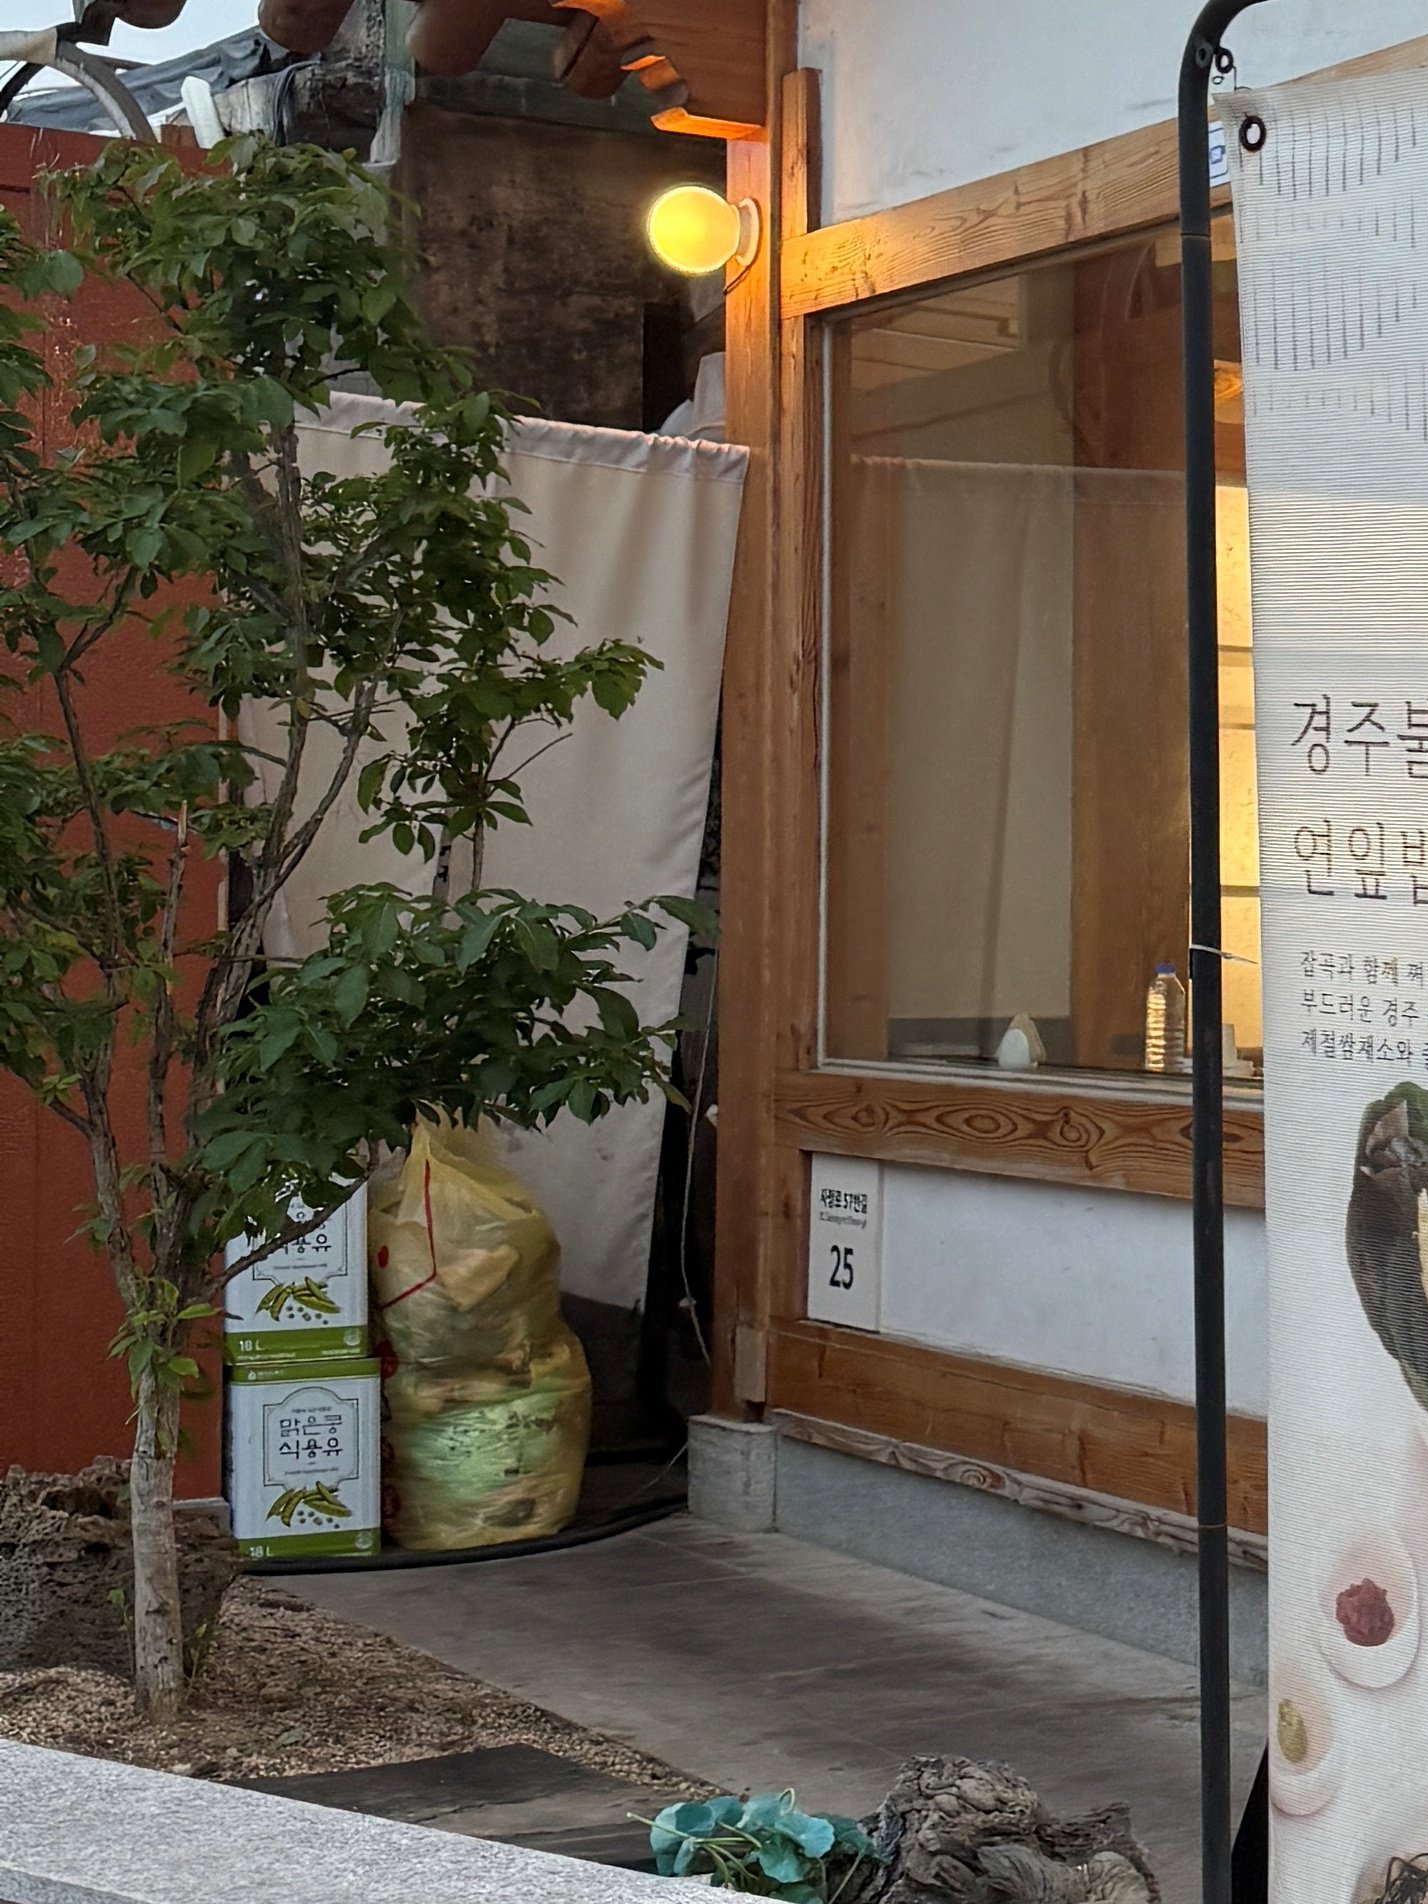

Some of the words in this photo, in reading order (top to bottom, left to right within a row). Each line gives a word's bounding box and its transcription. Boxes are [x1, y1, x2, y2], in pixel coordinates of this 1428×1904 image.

[1301, 950, 1354, 980] 잡곡과
[1363, 955, 1399, 986] 함께
[1301, 989, 1374, 1023] 부드러운
[1382, 997, 1420, 1027] 경주
[1302, 1026, 1414, 1067] 제철쌈채소와
[829, 1244, 854, 1290] 25
[279, 1437, 343, 1460] 식용유
